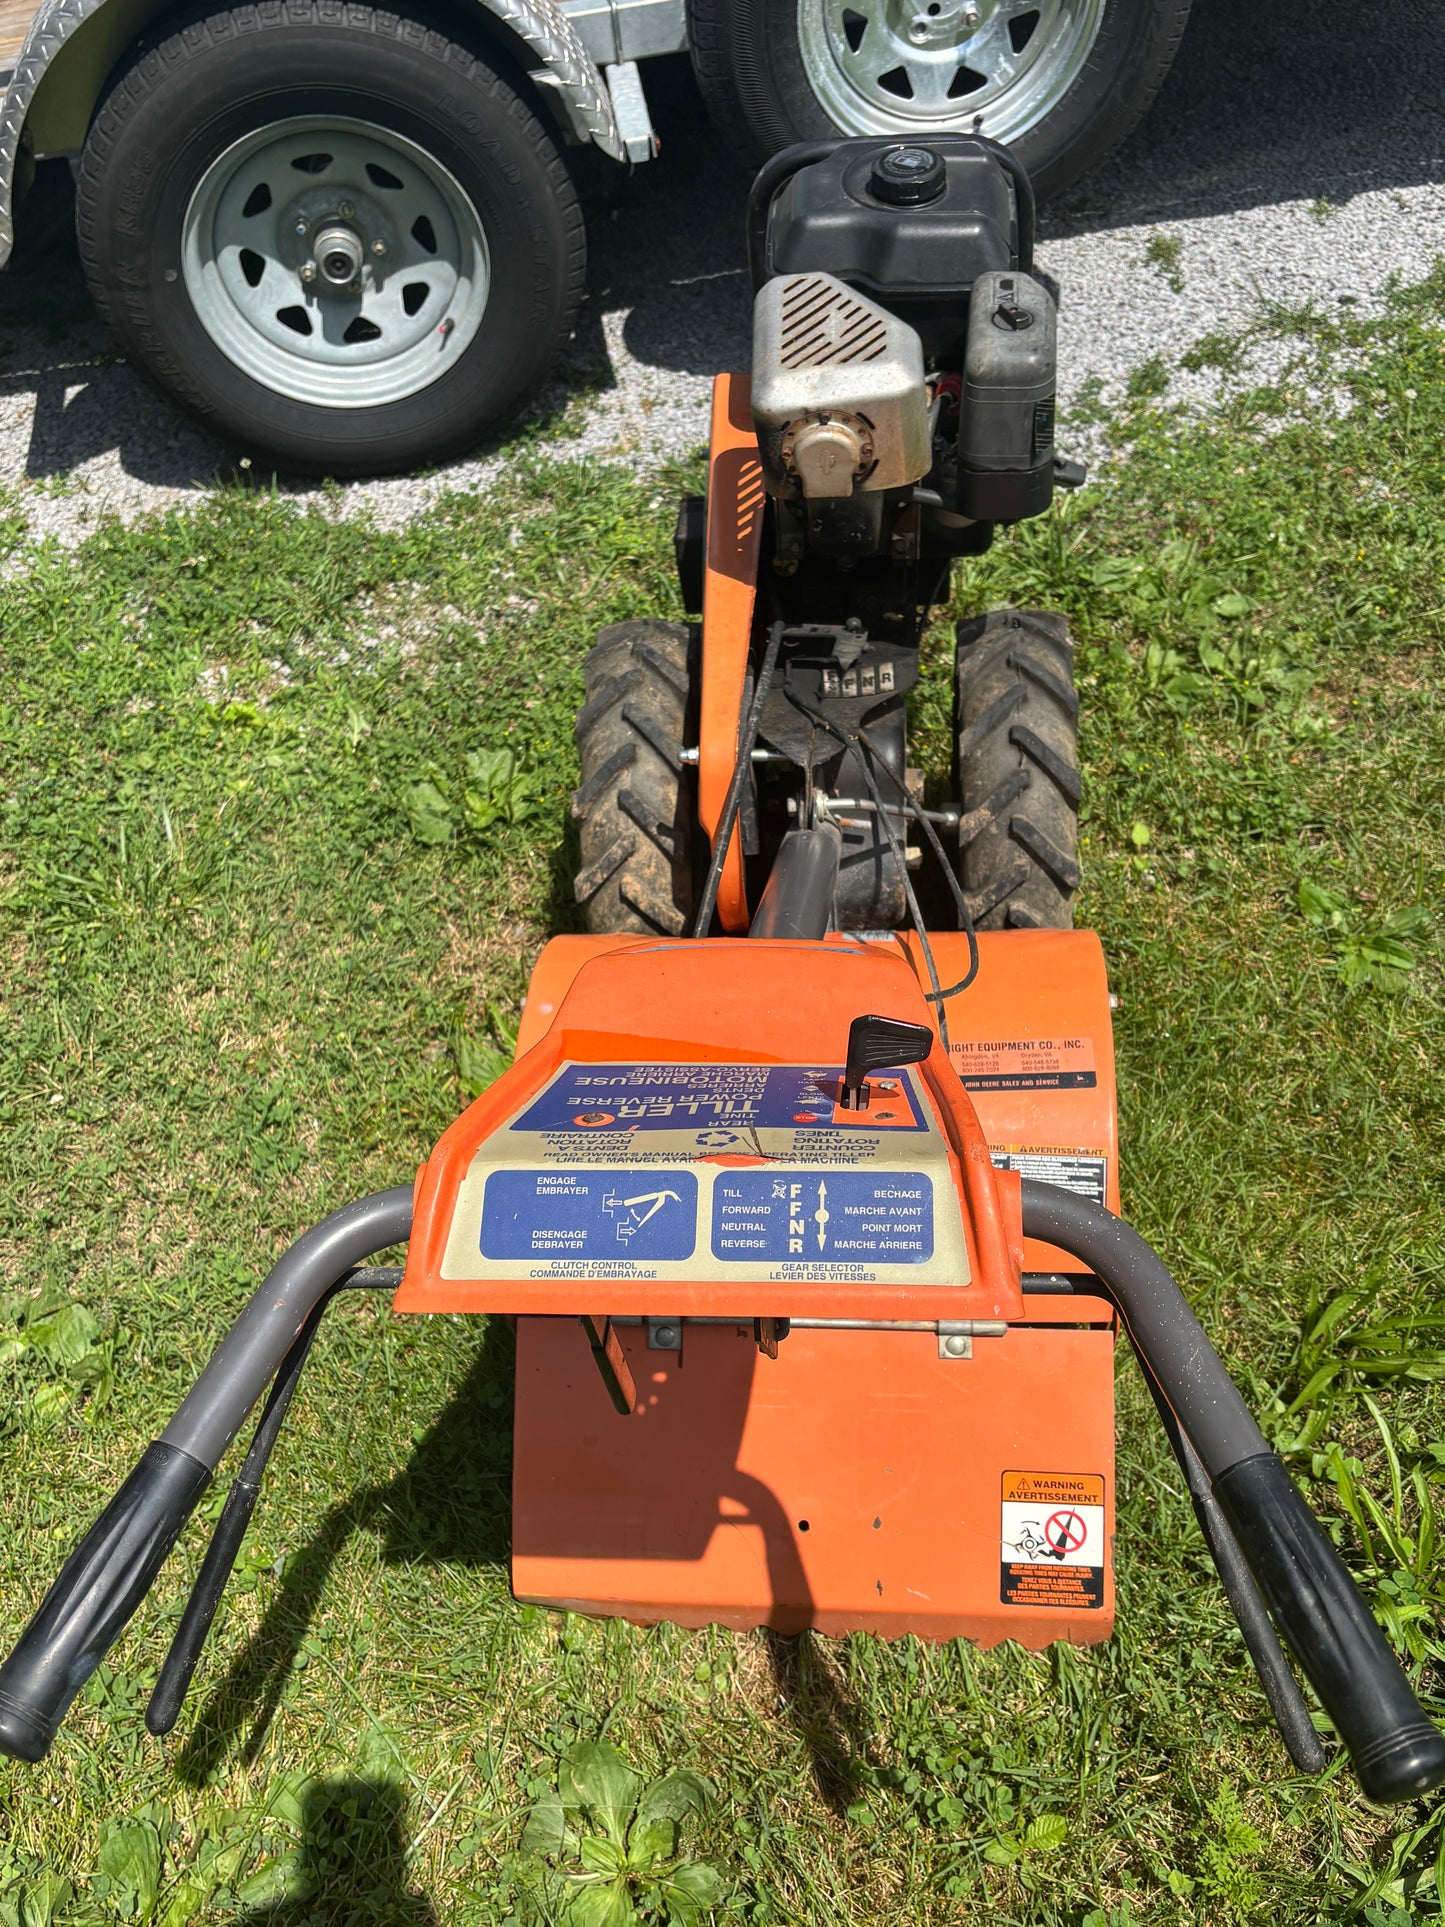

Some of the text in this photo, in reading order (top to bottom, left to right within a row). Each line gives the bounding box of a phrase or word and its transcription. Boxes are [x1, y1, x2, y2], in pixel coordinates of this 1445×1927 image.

[862, 676, 874, 688] N
[881, 672, 892, 684] R
[978, 1041, 1036, 1052] EQUIPMENT
[1064, 1039, 1085, 1049] INC.
[574, 1076, 768, 1086] MOTOBINEUSE
[1021, 1079, 1034, 1087] AND
[567, 1093, 764, 1105] POWER REVERSE
[617, 1101, 759, 1118] TILLER
[1028, 1146, 1104, 1156] AVERTISSEMENT
[800, 1157, 860, 1165] MACHINE
[537, 1176, 577, 1185] ENGAGE
[536, 1187, 589, 1195] EMBRAYER
[723, 1189, 742, 1197] TILL
[790, 1184, 802, 1199] F
[874, 1190, 922, 1199] BECHAGE
[722, 1206, 771, 1214] FORWARD
[790, 1202, 802, 1217] F
[844, 1207, 922, 1215] MARCHE AVANT
[721, 1223, 766, 1231] NEUTRAL
[789, 1220, 804, 1235] N
[862, 1223, 923, 1232] POINT MORT
[532, 1230, 588, 1239] DISENGAGE
[531, 1240, 583, 1249] DEBRAYER
[720, 1240, 766, 1248] REVERSE
[789, 1239, 803, 1253] R
[834, 1240, 923, 1249] MARCHE ARRIERE
[551, 1261, 637, 1270] CLUTCH CONTROL
[781, 1263, 864, 1273] GEAR SELECTOR
[529, 1269, 657, 1278] COMMANDE D'EMBRAYAGE
[769, 1272, 876, 1281] LEVIER DES VITESSES
[1033, 1480, 1084, 1490] WARNING
[1008, 1491, 1098, 1502] AVERTISSEMENT
